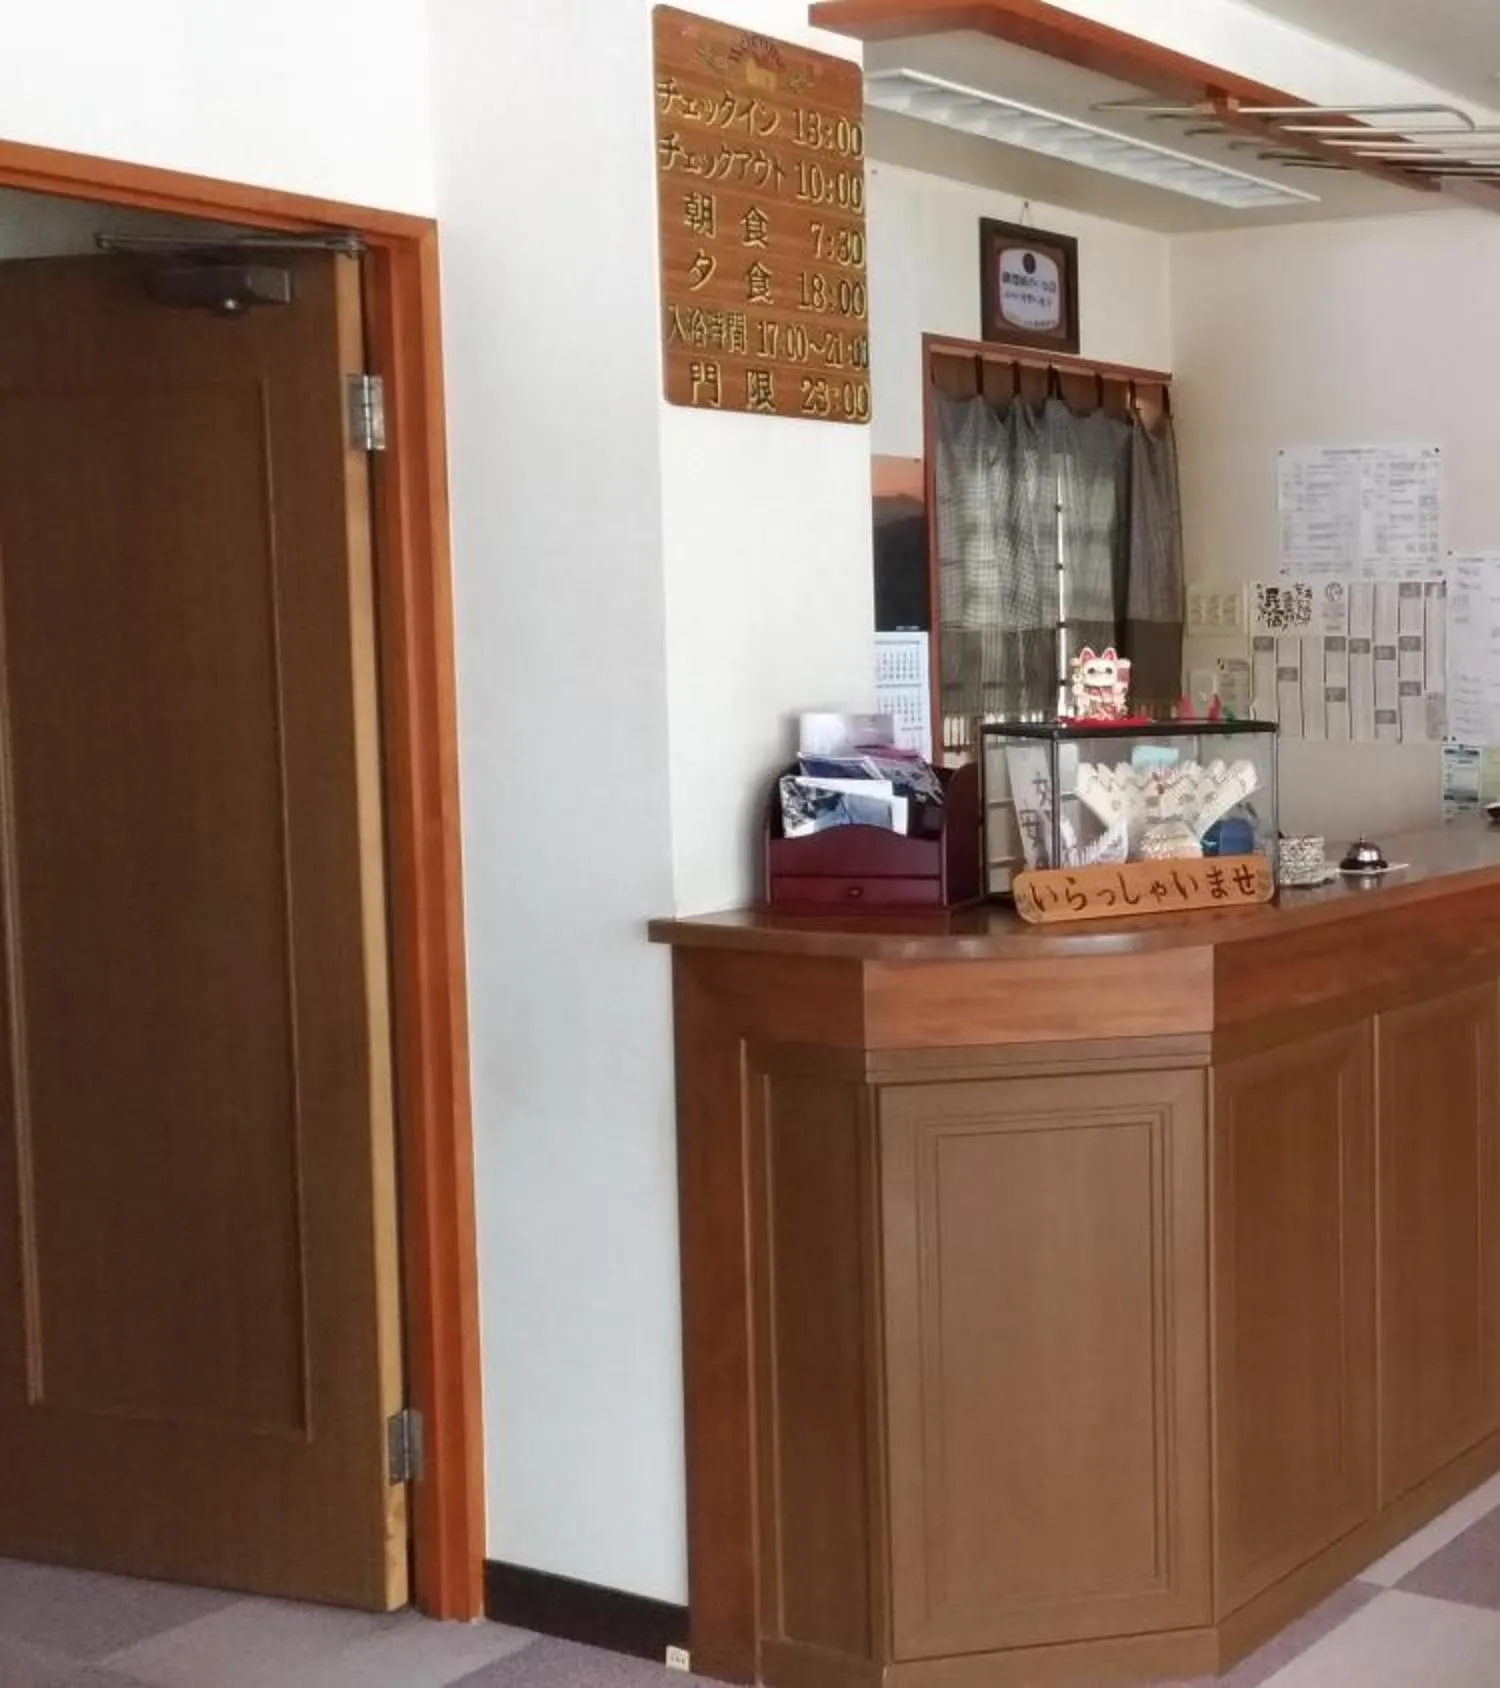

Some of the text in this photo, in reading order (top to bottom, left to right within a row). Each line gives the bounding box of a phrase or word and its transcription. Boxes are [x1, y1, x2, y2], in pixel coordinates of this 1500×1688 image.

[657, 77, 865, 161] チェックイン 13:00
[657, 132, 864, 216] チェックアウト 10:00
[810, 221, 865, 270] 7:30
[797, 271, 867, 320] 18:00
[668, 304, 748, 356] 入浴時間
[801, 376, 870, 421] 23:00
[1029, 862, 1256, 912] いらっしゃいませ
